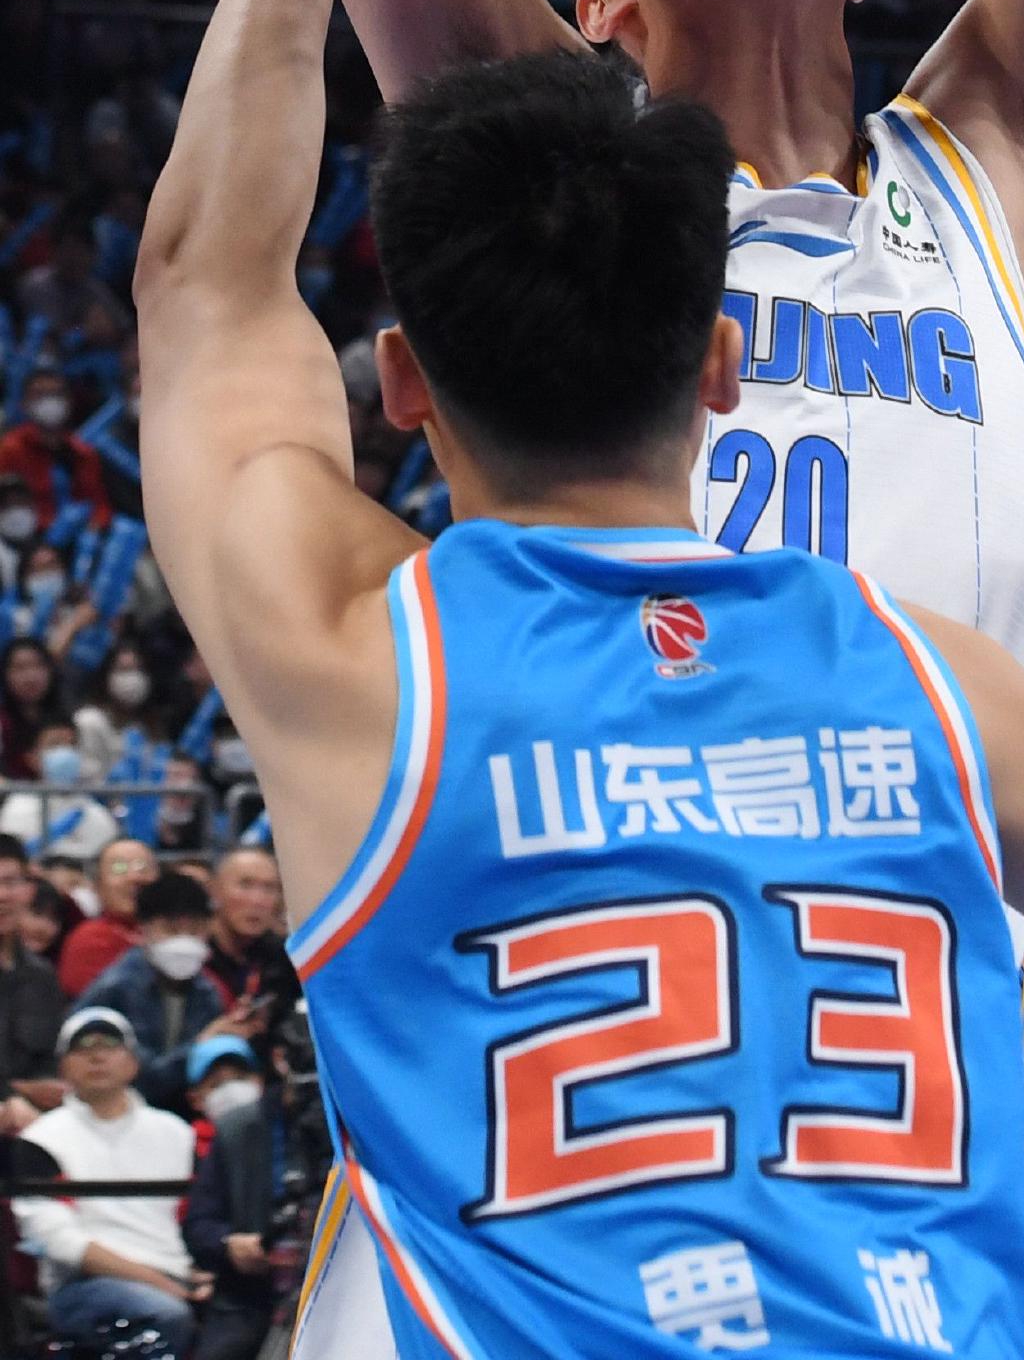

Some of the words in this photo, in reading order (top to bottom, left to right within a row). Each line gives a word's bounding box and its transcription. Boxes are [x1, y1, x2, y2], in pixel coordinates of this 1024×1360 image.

[882, 242, 911, 261] CHINA
[912, 255, 941, 264] LIFE
[722, 288, 984, 426] IJING
[709, 428, 850, 566] 20
[488, 726, 921, 859] 山东高速
[452, 883, 970, 1228] 23
